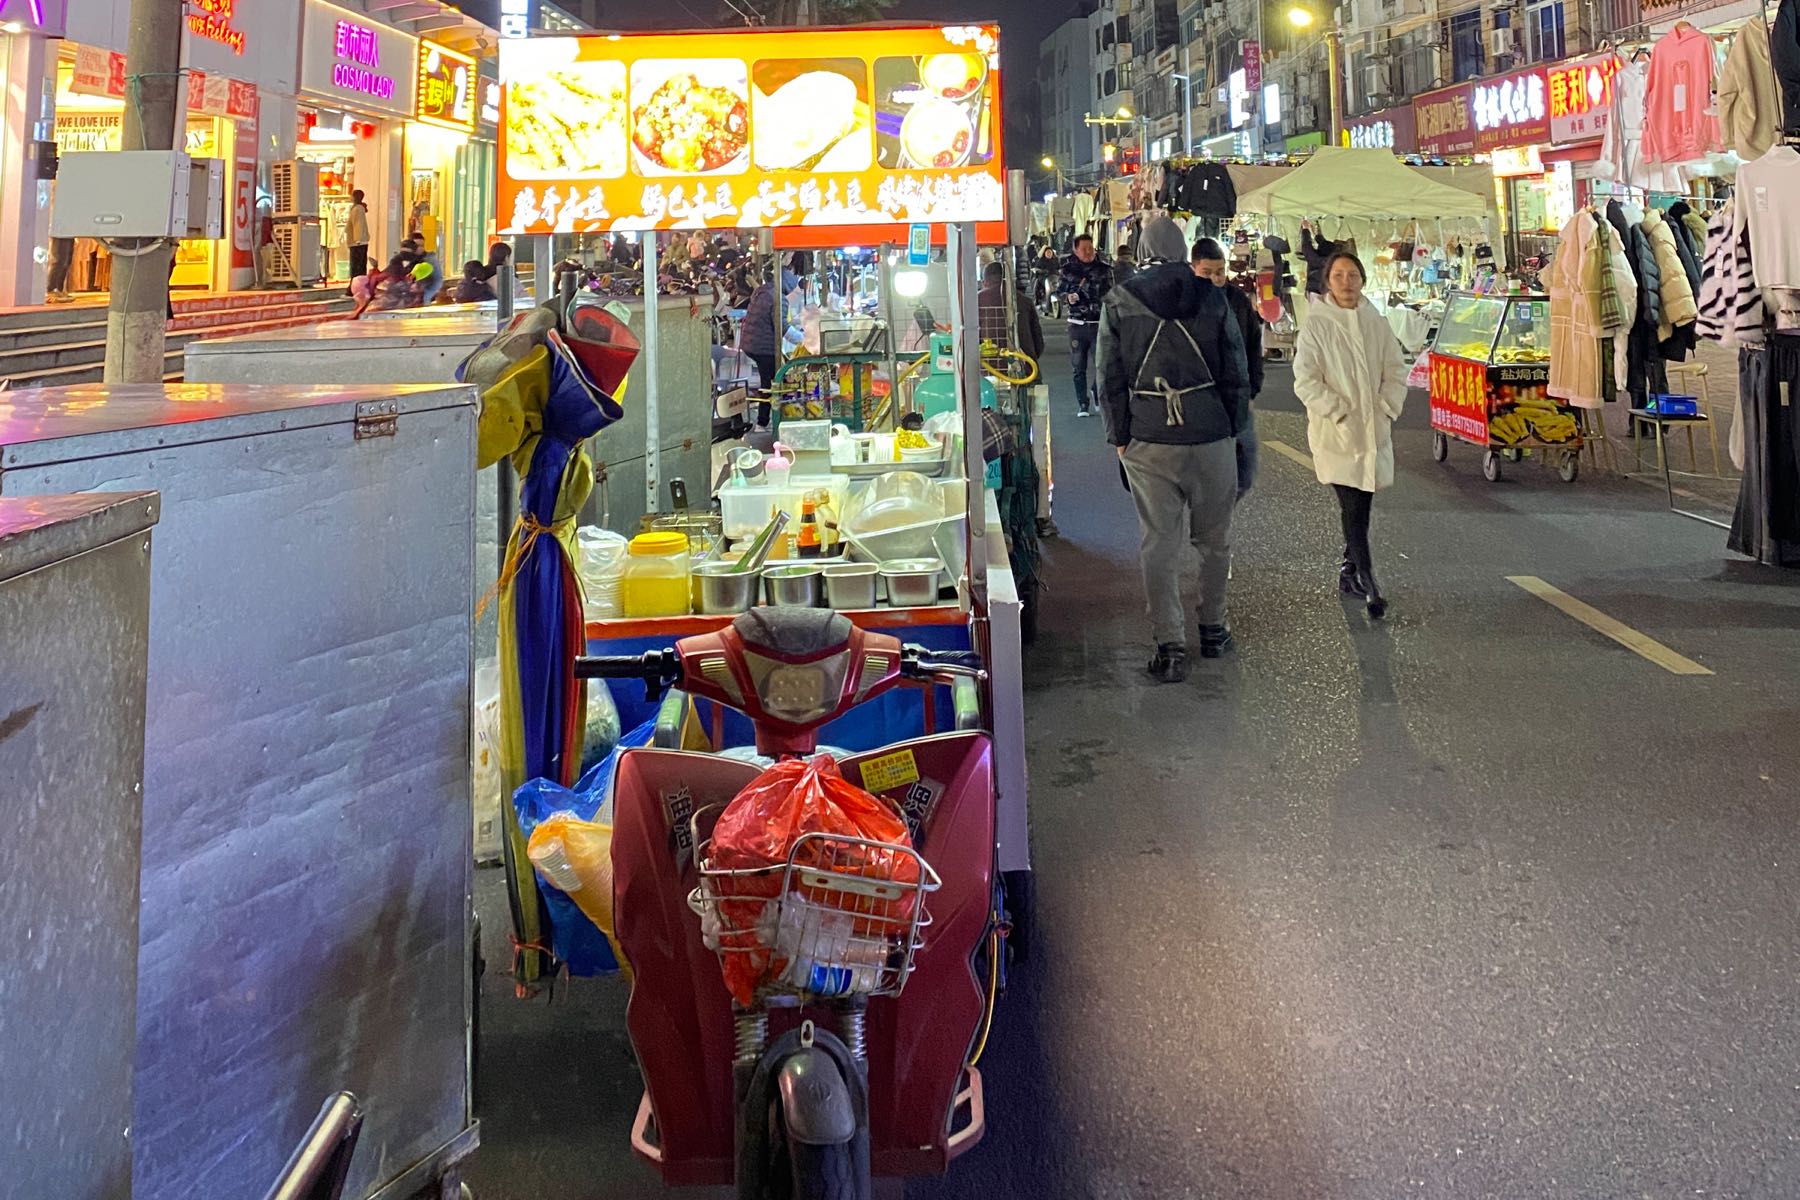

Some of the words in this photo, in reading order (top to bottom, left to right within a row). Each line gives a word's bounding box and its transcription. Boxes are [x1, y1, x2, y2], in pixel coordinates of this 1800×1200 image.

[336, 19, 380, 69] 都市丽人
[334, 62, 370, 94] COSMO
[371, 76, 396, 100] LADY
[57, 116, 73, 128] WE
[74, 116, 98, 128] LOVE
[100, 116, 119, 128] LIFE
[988, 462, 1001, 480] 20
